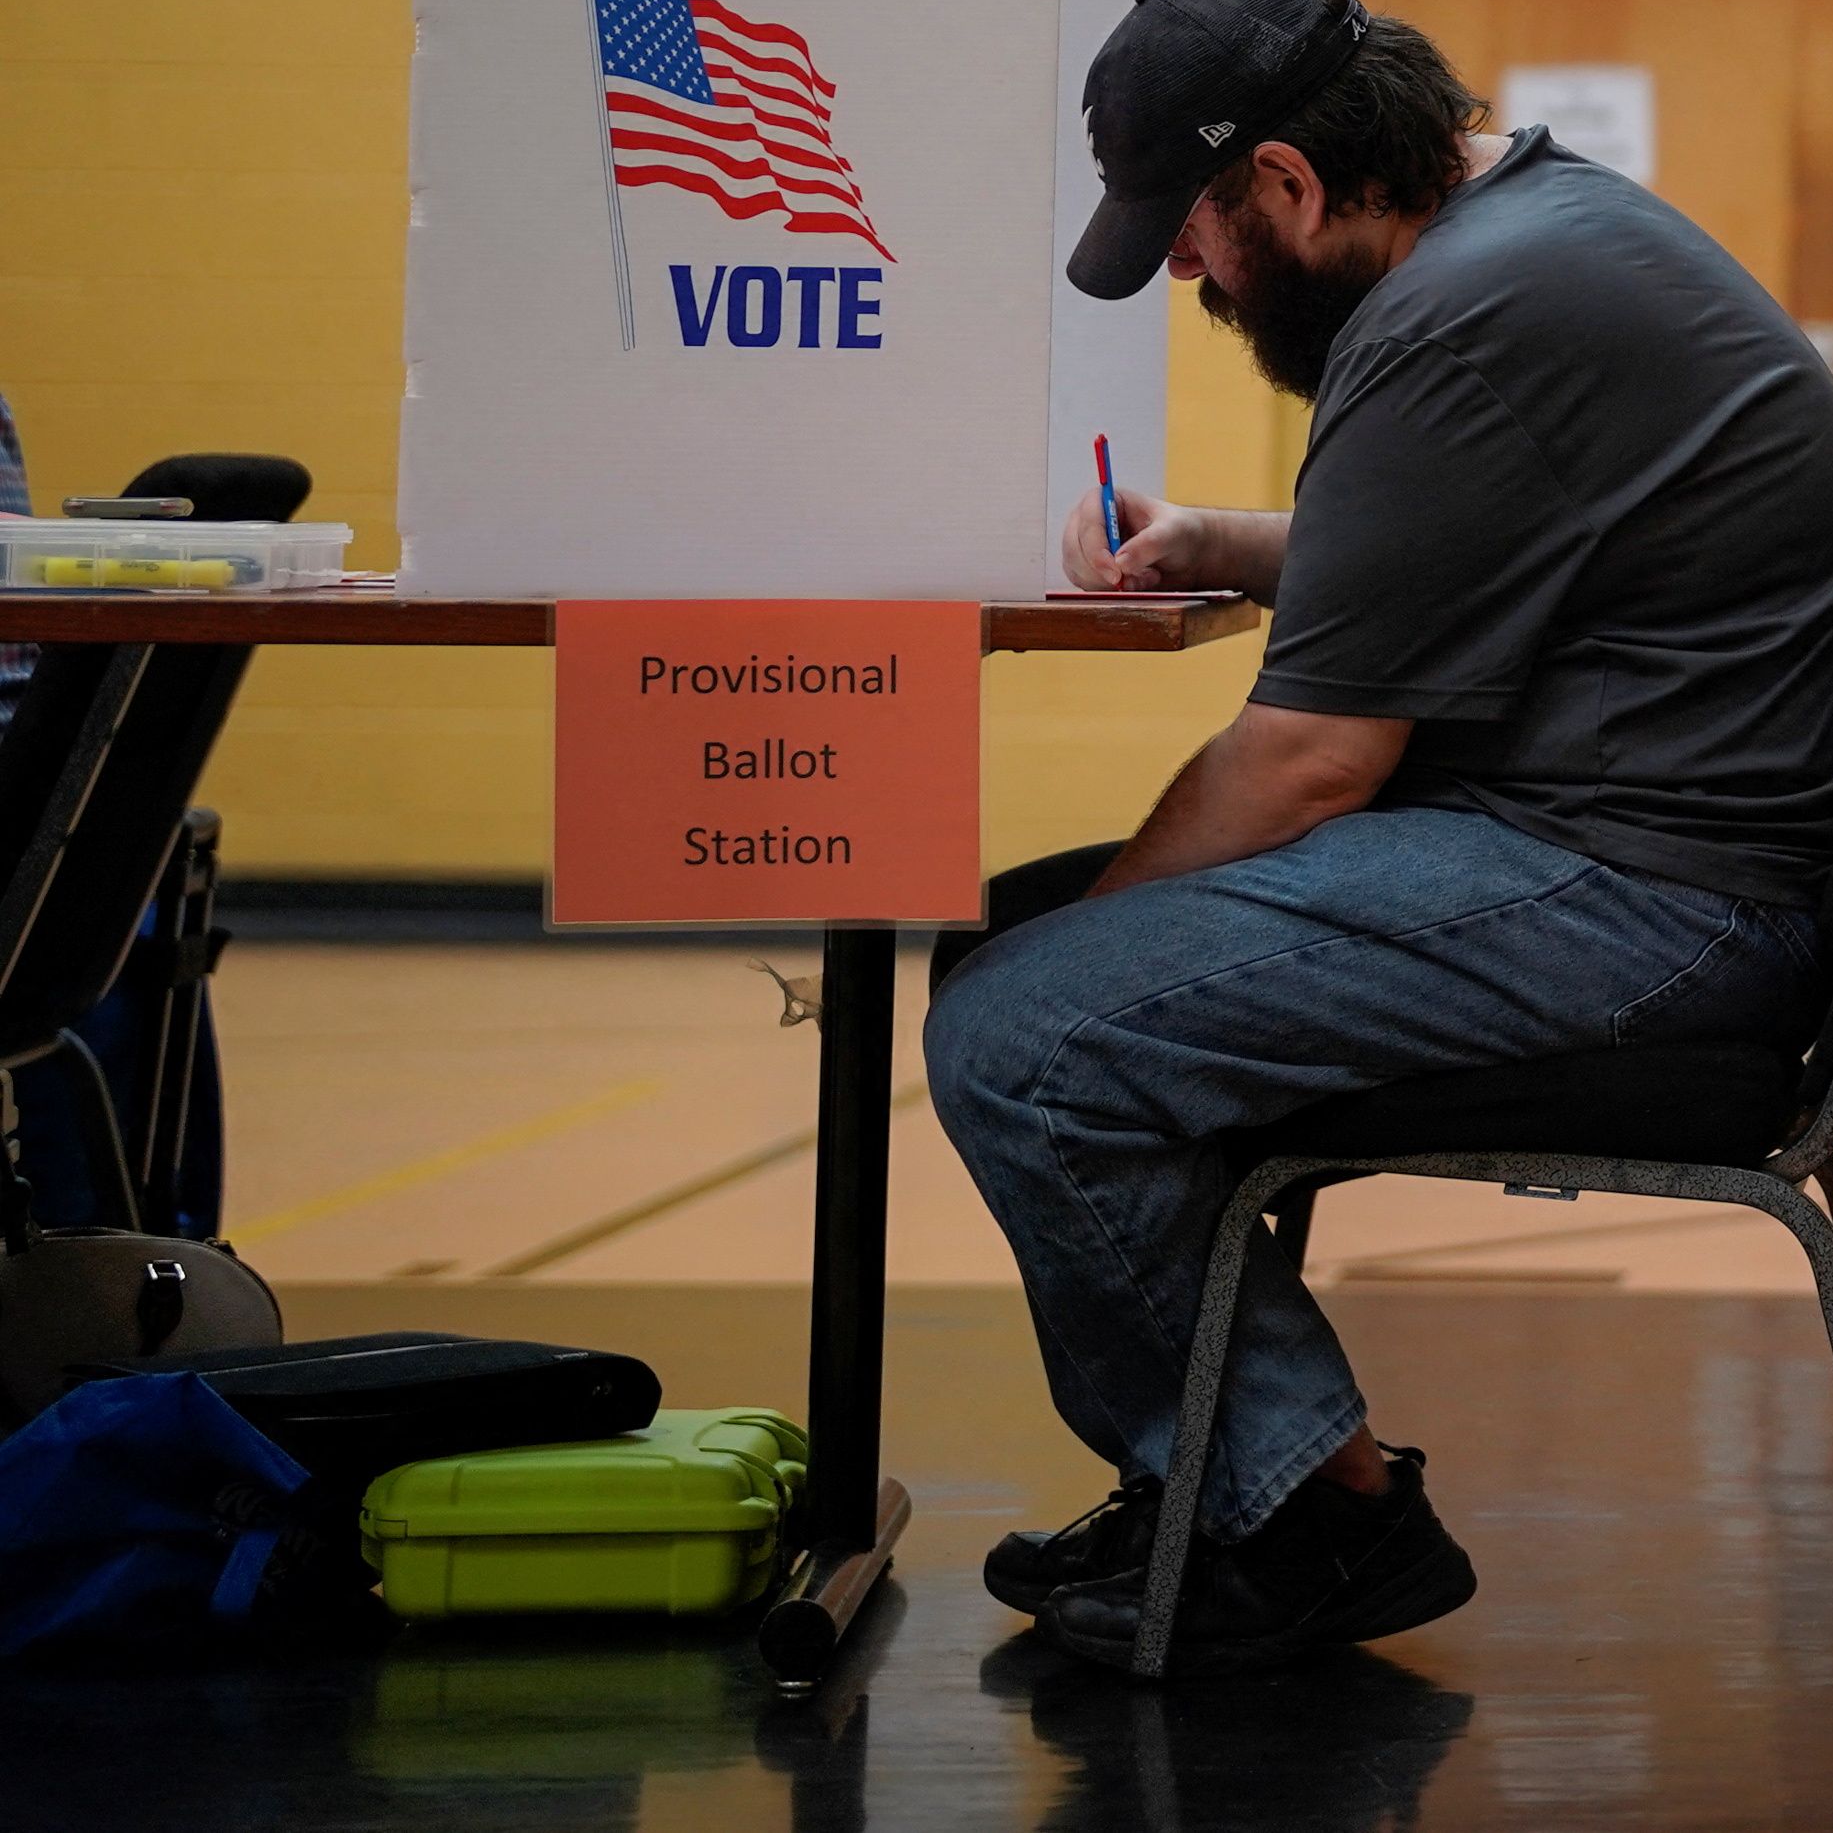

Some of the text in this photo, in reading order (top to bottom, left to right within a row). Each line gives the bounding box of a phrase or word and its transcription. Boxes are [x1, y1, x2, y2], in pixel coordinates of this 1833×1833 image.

[669, 265, 883, 349] VOTE
[640, 654, 897, 695] Provisional
[703, 738, 837, 780] Ballot
[684, 825, 851, 866] Station
